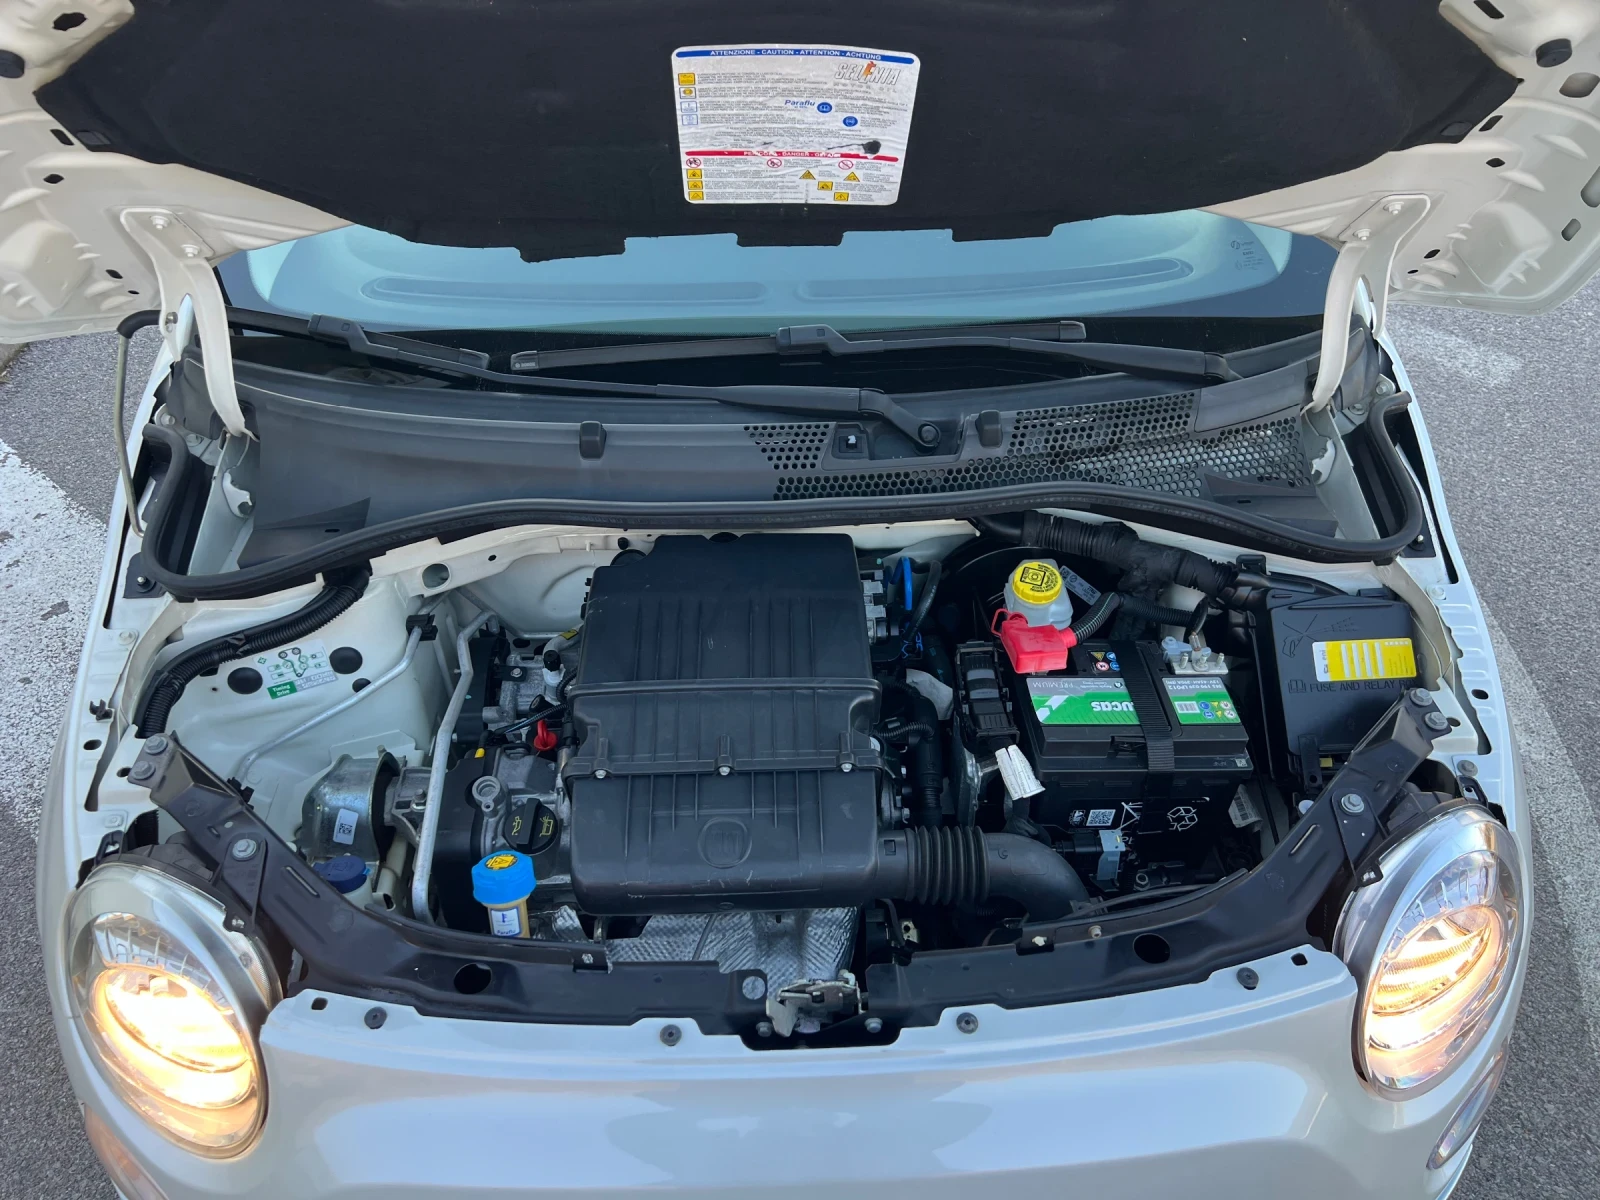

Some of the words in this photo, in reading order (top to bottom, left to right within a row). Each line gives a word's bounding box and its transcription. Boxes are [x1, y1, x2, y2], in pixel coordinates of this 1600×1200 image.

[799, 49, 839, 57] ATTENTION
[845, 52, 881, 60] ACHTUNG
[834, 61, 901, 86] SELENIA
[784, 99, 815, 107] Paraflu
[1310, 684, 1336, 692] FUSE
[1340, 683, 1360, 691] AND
[1364, 681, 1396, 690] RELAY
[1091, 701, 1134, 711] ucas
